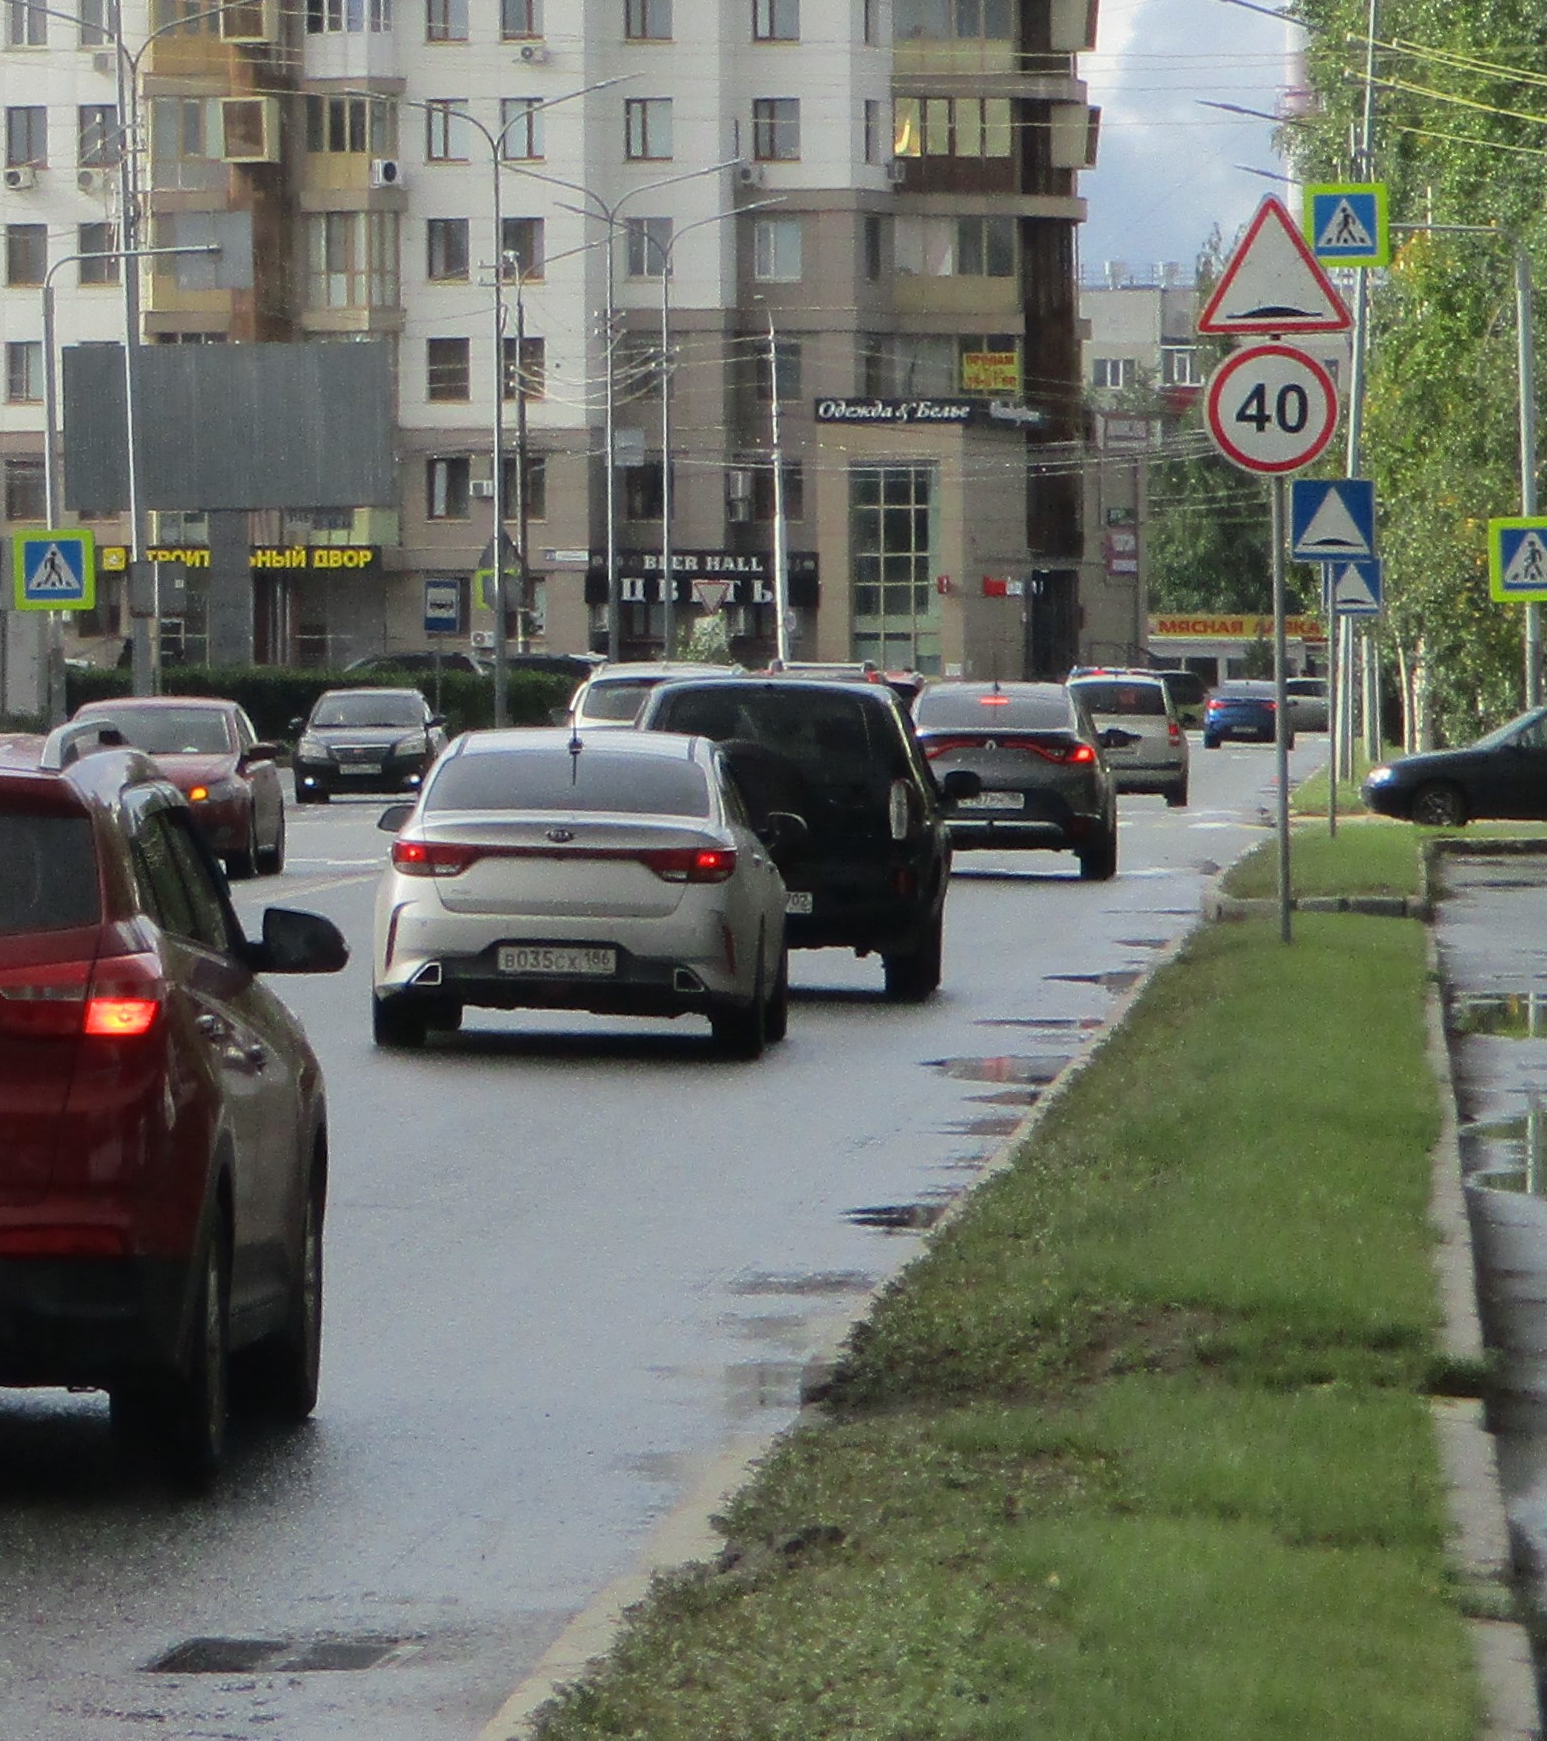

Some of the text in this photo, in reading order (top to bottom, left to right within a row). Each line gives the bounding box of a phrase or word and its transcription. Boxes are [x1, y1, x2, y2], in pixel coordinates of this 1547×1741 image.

[818, 400, 892, 420] Одежда
[916, 403, 970, 419] Белье
[1235, 382, 1309, 434] 40
[131, 546, 374, 569] ТРОИТНЫЙ ДВОР
[706, 556, 763, 571] HALL
[1158, 620, 1243, 634] МЯСНАЯ
